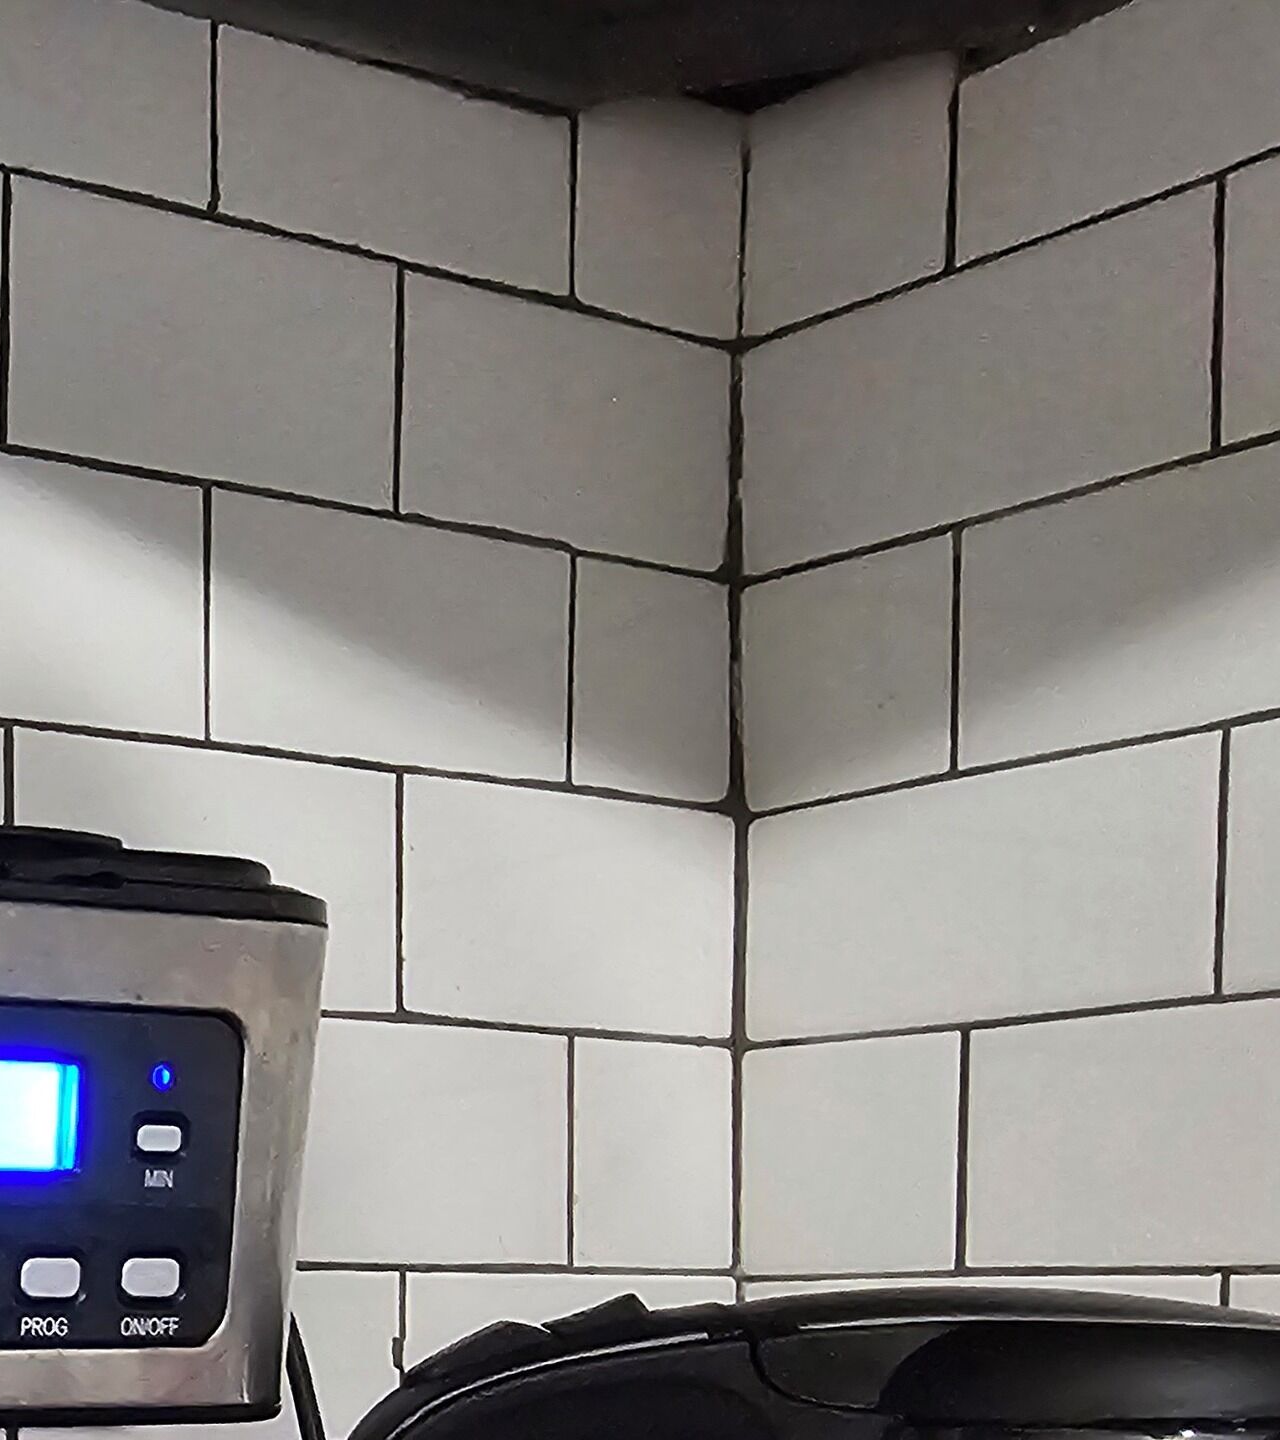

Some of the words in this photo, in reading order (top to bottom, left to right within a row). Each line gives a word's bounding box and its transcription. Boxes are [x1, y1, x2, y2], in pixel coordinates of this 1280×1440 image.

[144, 1168, 174, 1188] MIN
[20, 1316, 69, 1336] PROG
[120, 1317, 180, 1336] ON/OFF
